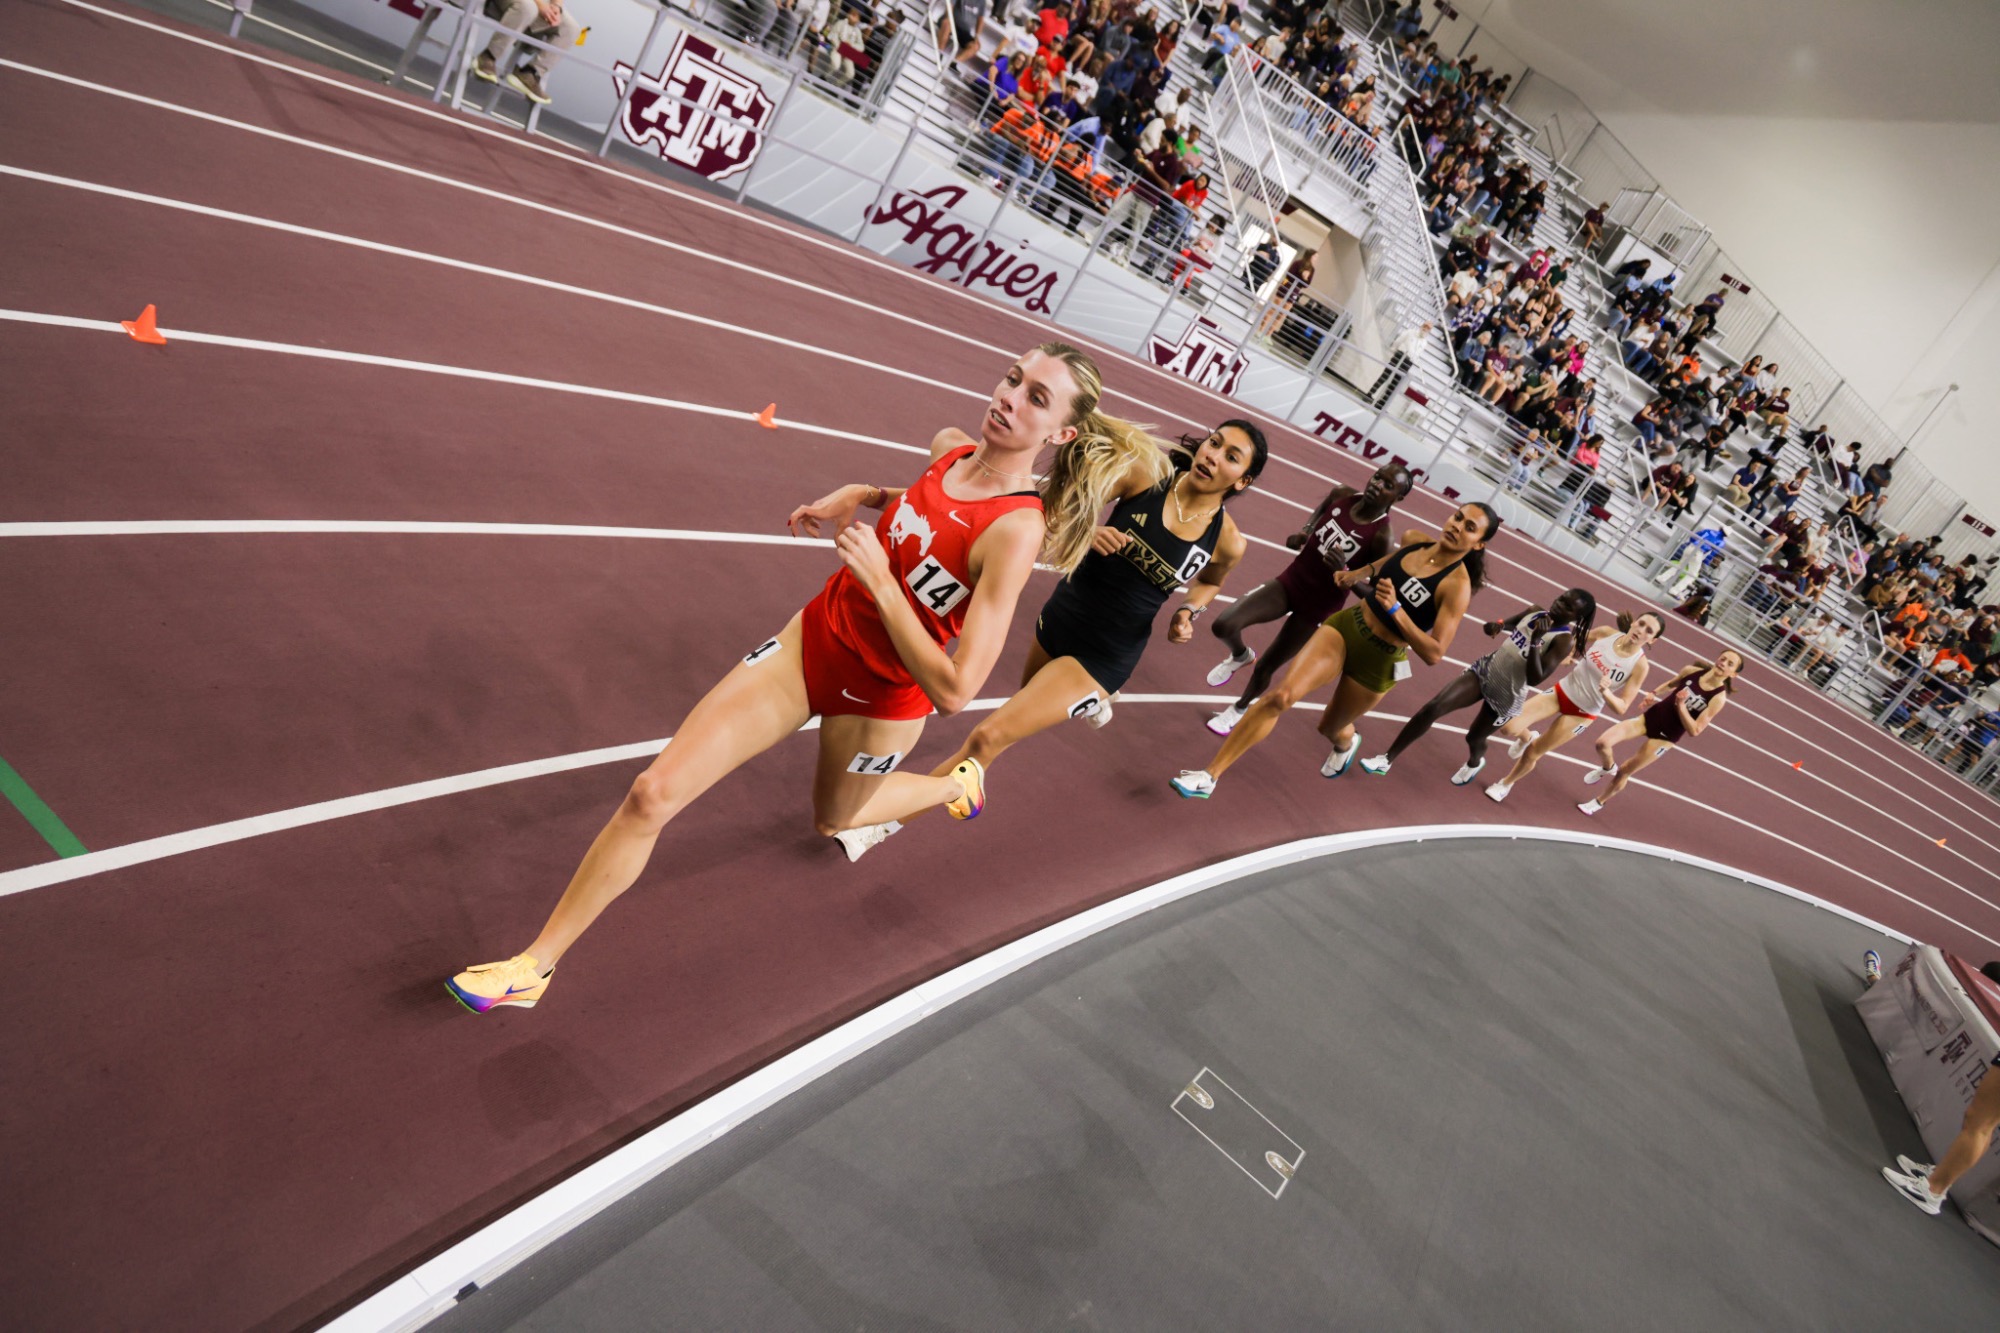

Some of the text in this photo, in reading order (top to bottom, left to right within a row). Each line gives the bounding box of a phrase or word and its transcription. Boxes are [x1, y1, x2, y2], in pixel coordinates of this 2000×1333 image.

[864, 185, 1058, 314] Aggies
[1181, 551, 1206, 581] 6
[912, 563, 961, 610] 14
[1403, 580, 1427, 603] 15
[1352, 606, 1397, 655] NIKE PRO
[1609, 668, 1625, 682] 10
[857, 754, 895, 774] 14
